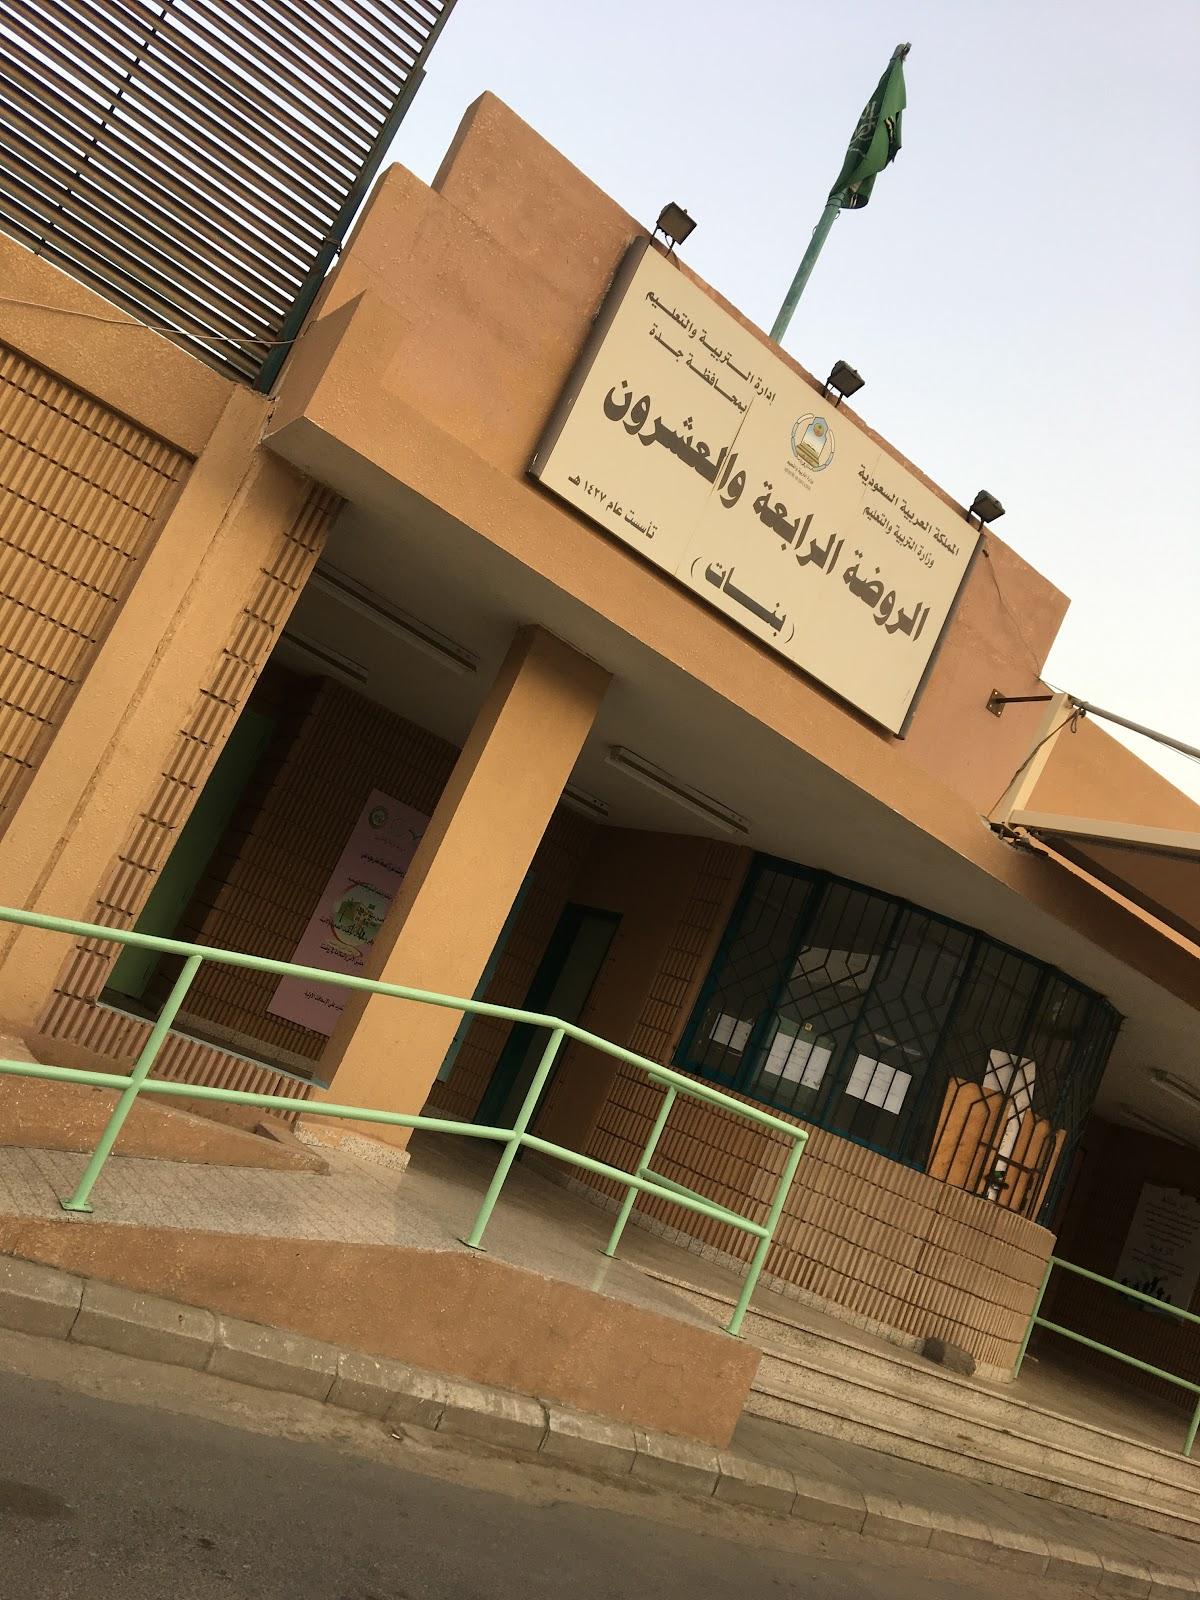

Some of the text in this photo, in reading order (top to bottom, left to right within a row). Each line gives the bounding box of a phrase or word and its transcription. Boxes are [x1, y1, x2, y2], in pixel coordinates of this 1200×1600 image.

[645, 291, 776, 406] إدارة التربية والتعليم
[649, 323, 748, 414] بمحافظة جدة
[603, 379, 931, 642] الروضة الرابعة والعشرون
[605, 501, 623, 516] عام
[624, 509, 658, 539] تأسست
[858, 464, 960, 556] المملكة العربية السعودية
[862, 505, 935, 568] وزارة التربية والتعليم
